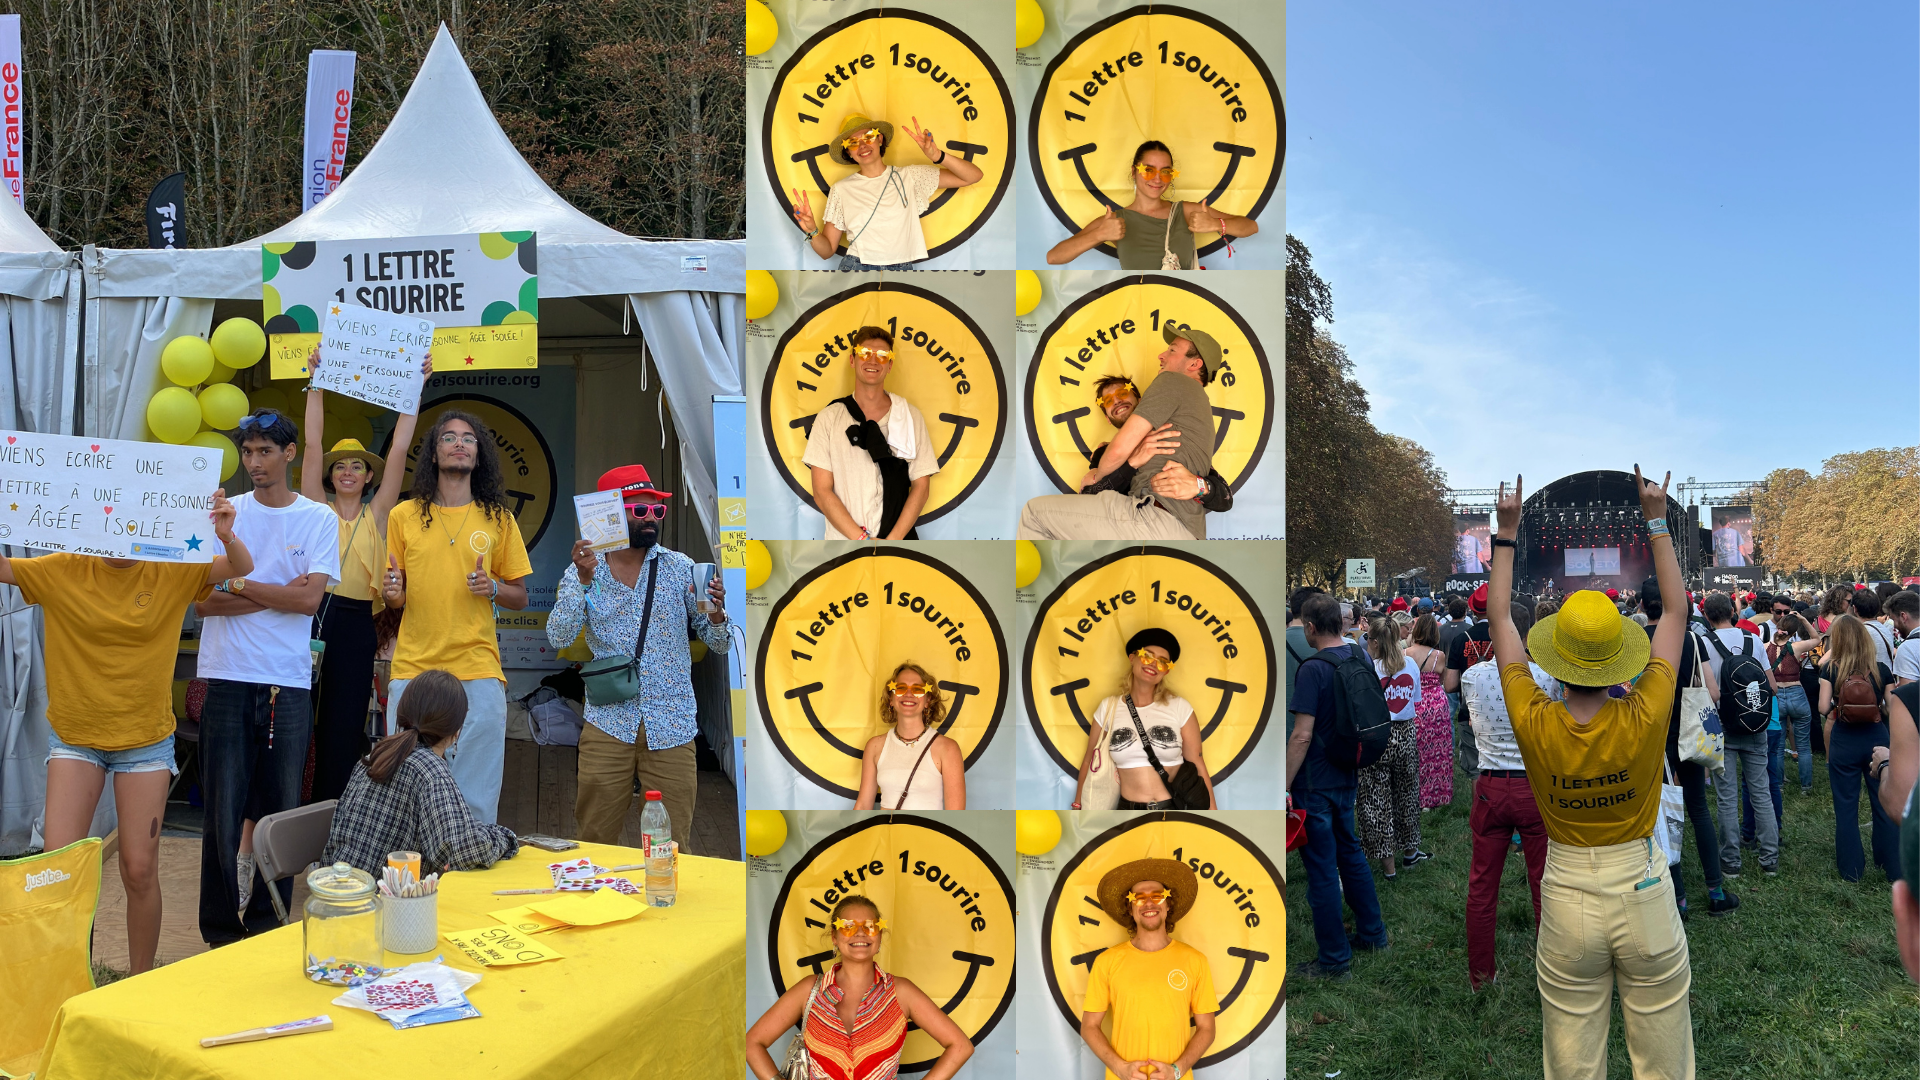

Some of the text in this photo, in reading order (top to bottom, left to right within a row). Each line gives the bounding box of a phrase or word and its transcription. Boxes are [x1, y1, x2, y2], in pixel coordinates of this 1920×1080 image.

[803, 54, 875, 108] lettre
[904, 53, 978, 121] sourire
[1069, 51, 1143, 106] lettre
[1172, 51, 1246, 123] sourire
[798, 112, 819, 124] 1
[1065, 110, 1086, 122] 1
[343, 249, 455, 282] 1 LETTRE
[356, 282, 464, 315] SOURIRE
[338, 320, 431, 348] VIENS ECRIRE
[432, 336, 460, 346] SONNE
[1064, 319, 1136, 371] lettre
[277, 348, 302, 360] VIENS
[329, 338, 351, 351] UNE
[361, 346, 397, 359] LETTRE
[802, 326, 869, 377] lettr
[328, 360, 413, 379] UNE PERSONNE
[901, 326, 971, 395] sourire
[319, 371, 351, 385] ÂGÉE
[427, 372, 540, 388] re1sourire.org
[796, 380, 818, 392] 1
[1060, 375, 1080, 386] 1
[0, 447, 164, 475] VIENS ECRIRE UNE
[0, 479, 214, 510] LETTRE À UNE PERSONNE
[28, 504, 82, 529] ÂGÉE
[41, 542, 66, 550] LETTRE
[83, 547, 115, 557] SOURIRE
[1566, 560, 1618, 569] SOCETY
[1446, 579, 1469, 591] ROCK
[514, 616, 538, 625] clics
[796, 592, 869, 646] lettre
[897, 592, 970, 662] sourire
[1063, 590, 1136, 642] lettre
[1165, 590, 1238, 659] sourire
[791, 649, 812, 661] 1
[1058, 646, 1079, 658] 1
[1551, 769, 1630, 789] 1 LETTRE
[1548, 788, 1637, 809] 1 SOURIRE
[810, 860, 884, 913] lettre
[913, 860, 986, 932] sourire
[1079, 914, 1100, 926] 1
[1189, 857, 1260, 928] sourire
[805, 917, 826, 929] 1
